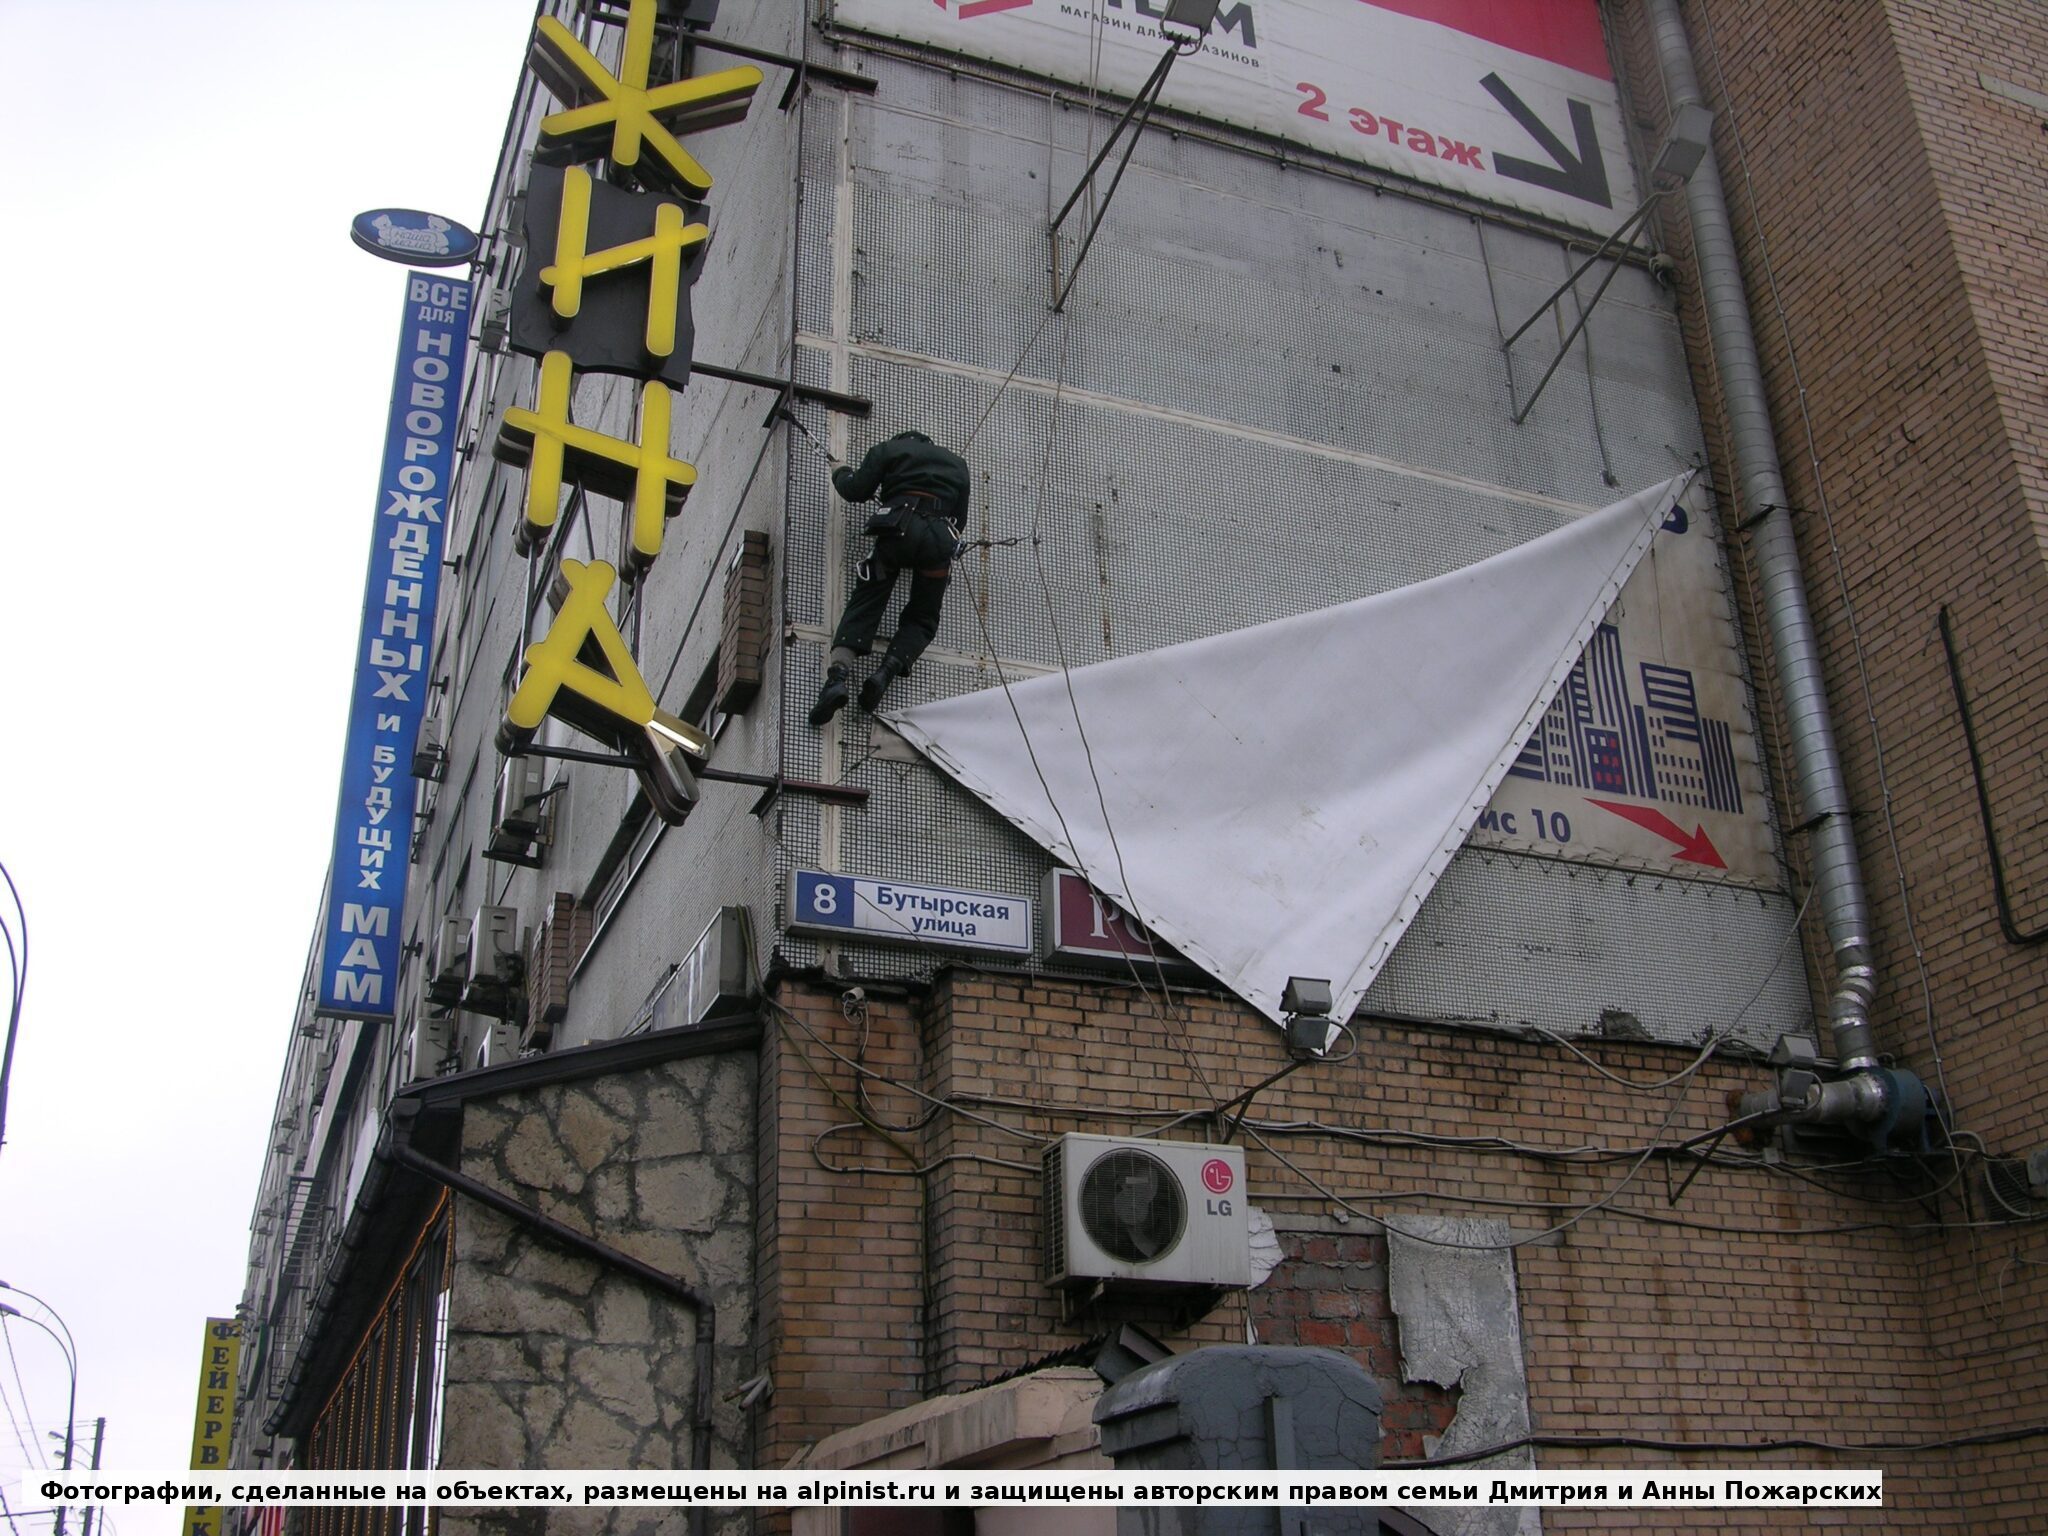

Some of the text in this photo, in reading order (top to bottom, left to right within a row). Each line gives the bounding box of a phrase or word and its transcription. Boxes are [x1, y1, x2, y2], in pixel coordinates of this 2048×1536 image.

[1060, 4, 1131, 31] МАГАЗИН
[1296, 82, 1486, 171] 2 этаж
[410, 278, 469, 311] ВСЕ
[369, 329, 452, 701] НОВОРОЖДЕННЫХ
[358, 745, 396, 891] БУДУЩИХ
[1531, 808, 1571, 843] 10
[813, 883, 837, 914] 8
[877, 886, 1010, 920] Бутырская
[911, 916, 977, 937] улица
[333, 903, 390, 1005] МАМ
[1206, 1199, 1232, 1217] LG
[191, 1322, 234, 1536] ФЕЙЕРВК
